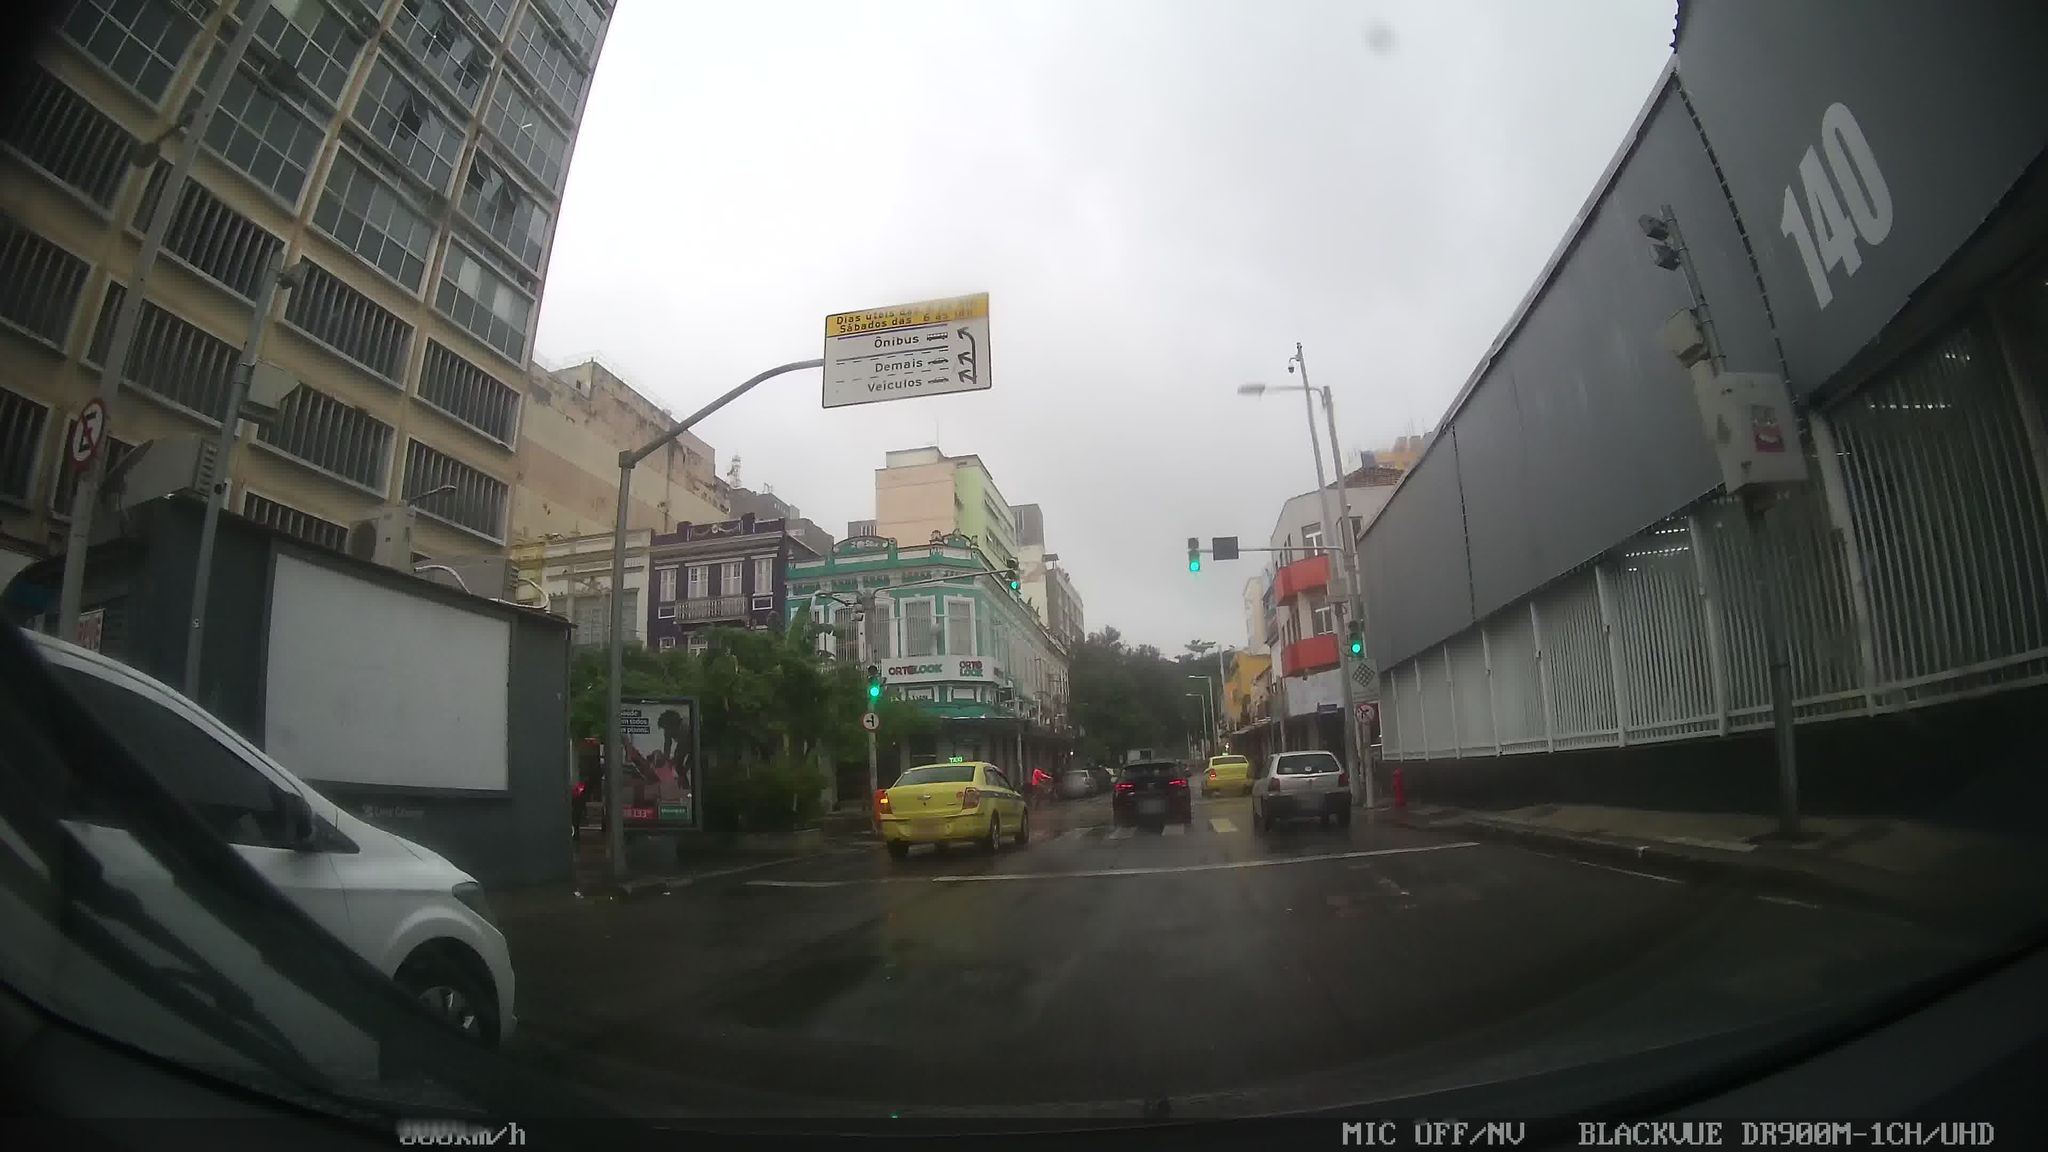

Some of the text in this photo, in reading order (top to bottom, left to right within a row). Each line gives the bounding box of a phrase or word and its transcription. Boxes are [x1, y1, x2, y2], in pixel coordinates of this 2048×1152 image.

[1779, 102, 1893, 310] 140
[836, 315, 861, 325] Dias
[839, 321, 887, 333] Sábados
[892, 316, 912, 325] das
[874, 334, 920, 349] Ônibus
[875, 359, 923, 372] Demais
